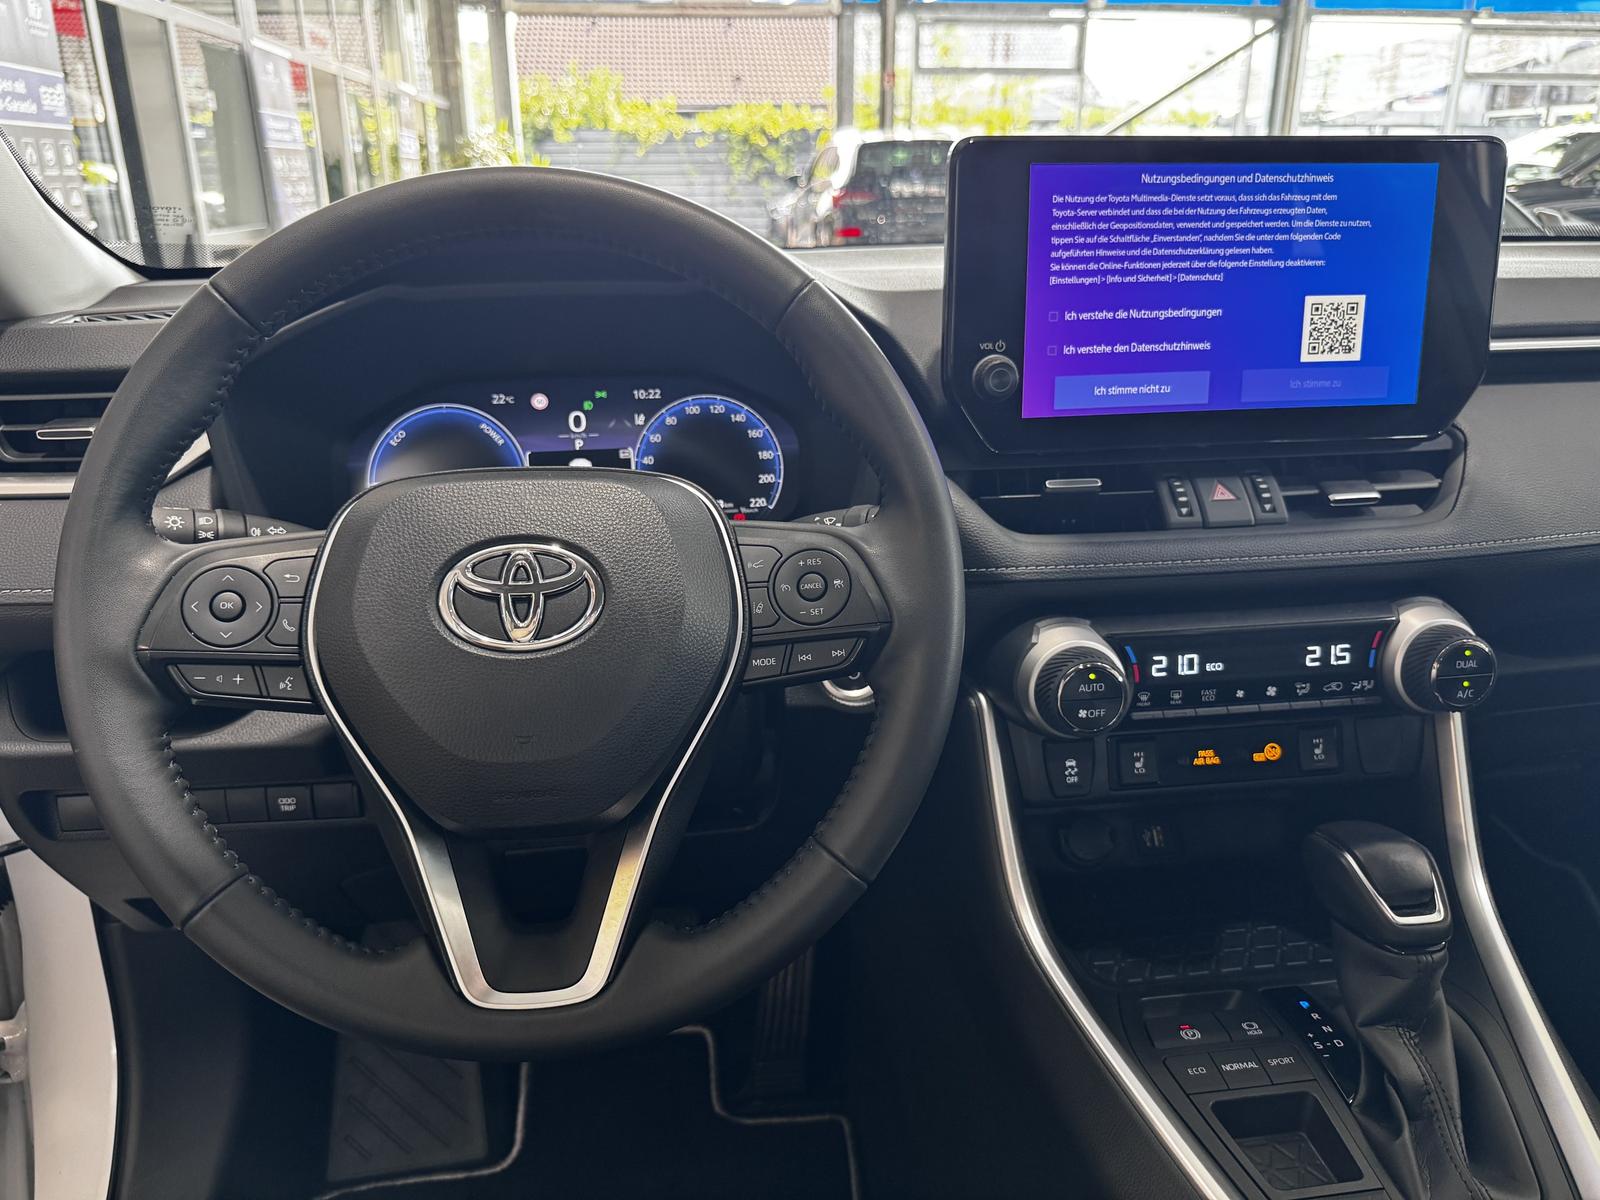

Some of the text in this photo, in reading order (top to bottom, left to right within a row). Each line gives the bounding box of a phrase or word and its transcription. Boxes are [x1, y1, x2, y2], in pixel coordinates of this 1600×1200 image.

[1142, 172, 1334, 186] Nutzungsbedingungen und Datenschutzhinweis
[1052, 195, 1064, 203] Die
[1065, 194, 1094, 204] Nutzung
[1095, 194, 1107, 202] der
[1108, 194, 1129, 204] Toyota
[1131, 194, 1196, 202] Multimedia-Dienste
[1198, 194, 1212, 202] setzt
[1214, 194, 1237, 202] voraus,
[1254, 193, 1267, 201] sich
[1268, 193, 1280, 201] das
[1281, 193, 1310, 202] Fahrzeug
[1052, 209, 1097, 218] Toyota-Server
[1098, 208, 1130, 216] verbindet
[1131, 208, 1144, 216] und
[1146, 208, 1160, 216] dass
[1162, 208, 1173, 216] die
[1173, 208, 1184, 216] bei
[1185, 208, 1196, 216] der
[1198, 208, 1226, 216] Nutzung
[1240, 206, 1272, 216] Fahrzeugs
[1273, 207, 1305, 216] erzeugten
[1306, 206, 1328, 215] Daten,
[1051, 222, 1096, 230] einschließlich
[1098, 222, 1109, 230] der
[1110, 221, 1175, 231] Geopositionsdaten,
[1211, 220, 1225, 228] und
[1225, 220, 1264, 230] gespeichert
[1265, 220, 1290, 228] werden.
[1314, 219, 1339, 227] Dienste
[1348, 220, 1372, 228] nutzen,
[1051, 236, 1073, 245] tippen
[1074, 236, 1084, 244] Sie
[1085, 236, 1097, 244] auf
[1110, 234, 1150, 243] Schaltfläche
[1290, 233, 1323, 242] folgenden
[1324, 232, 1341, 240] Code
[1051, 250, 1094, 259] aufgeführten
[1127, 248, 1140, 256] und
[1141, 248, 1152, 256] die
[1153, 247, 1224, 256] Datenschutzerklärung
[1225, 246, 1250, 256] gelesen
[1251, 246, 1274, 254] haben.
[1061, 262, 1086, 270] können
[1087, 262, 1098, 270] die
[1099, 261, 1160, 270] Online-Funktionen
[1162, 260, 1190, 270] jederzeit
[1191, 260, 1207, 268] über
[1207, 260, 1217, 268] die
[1218, 260, 1247, 269] folgende
[1249, 259, 1284, 268] Einstellung
[1285, 258, 1325, 267] deaktivieren:
[1050, 276, 1100, 285] [Einstellungen]
[1107, 275, 1120, 284] [Info
[1137, 274, 1172, 282] Sicherheit]
[1178, 273, 1223, 282] [Datenschutz]
[1065, 308, 1222, 320] Ich verstehe die Nutzungsbedingungen
[1064, 341, 1210, 354] Ich verstehe den Datenschutzhinweis
[633, 389, 661, 400] 10:22
[1094, 386, 1106, 396] Ich
[1108, 386, 1137, 394] stimme
[1139, 385, 1159, 394] nicht
[710, 406, 725, 414] 120
[568, 410, 586, 432] 0
[665, 417, 677, 425] 80
[390, 430, 406, 446] ECO
[480, 423, 504, 446] POWER
[650, 434, 661, 442] 60
[748, 430, 763, 438] 160
[575, 438, 584, 450] P
[642, 456, 654, 464] 40
[758, 451, 774, 459] 180
[758, 475, 775, 483] 200
[750, 498, 766, 507] 220
[806, 558, 822, 566] RES
[752, 658, 776, 666] MODE
[1206, 662, 1224, 672] ECO
[1456, 660, 1480, 668] DUAL
[1079, 683, 1104, 692] AUTO
[1456, 689, 1474, 699] A/C
[1088, 709, 1106, 717] OFF
[1310, 1012, 1322, 1020] R
[1313, 1039, 1344, 1049] S D
[1221, 1061, 1259, 1071] NORMAL
[1267, 1056, 1295, 1066] SPORT
[1187, 1067, 1207, 1075] ECO
